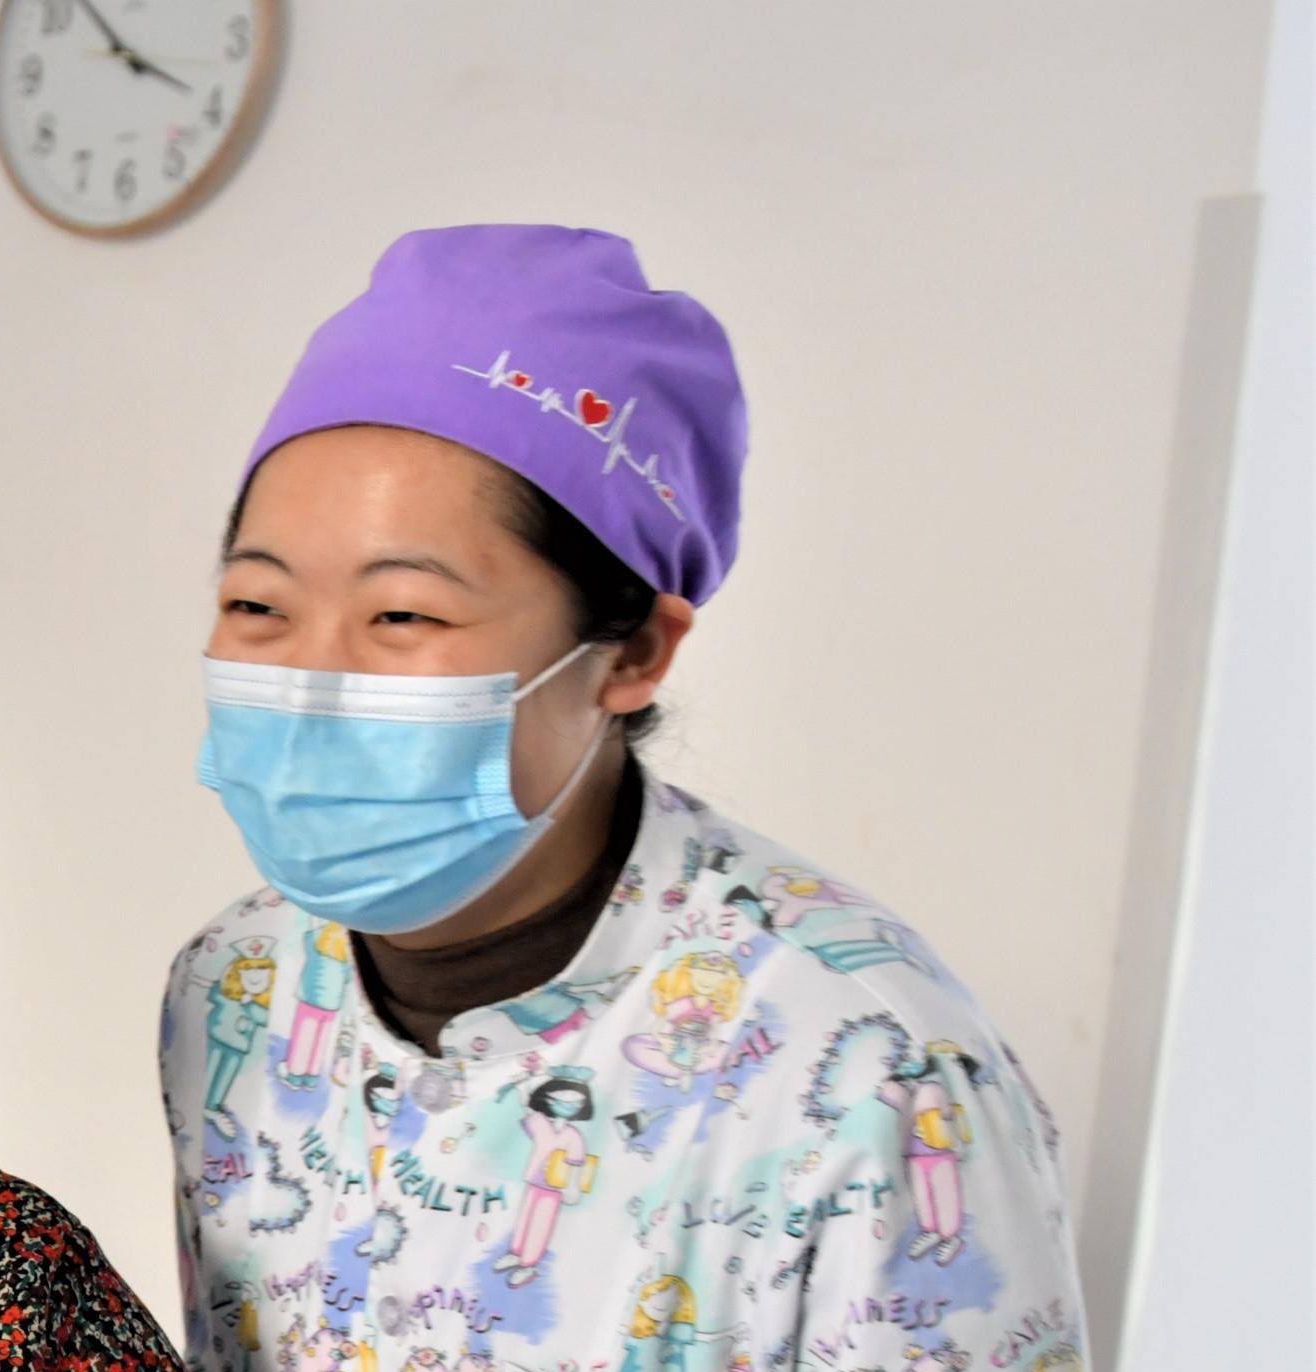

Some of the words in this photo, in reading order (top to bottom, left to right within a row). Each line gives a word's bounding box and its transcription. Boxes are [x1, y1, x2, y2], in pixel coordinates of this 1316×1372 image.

[224, 13, 251, 61] 3
[202, 84, 224, 128] 4
[114, 158, 138, 201] 6
[391, 1148, 507, 1216] HEALTH
